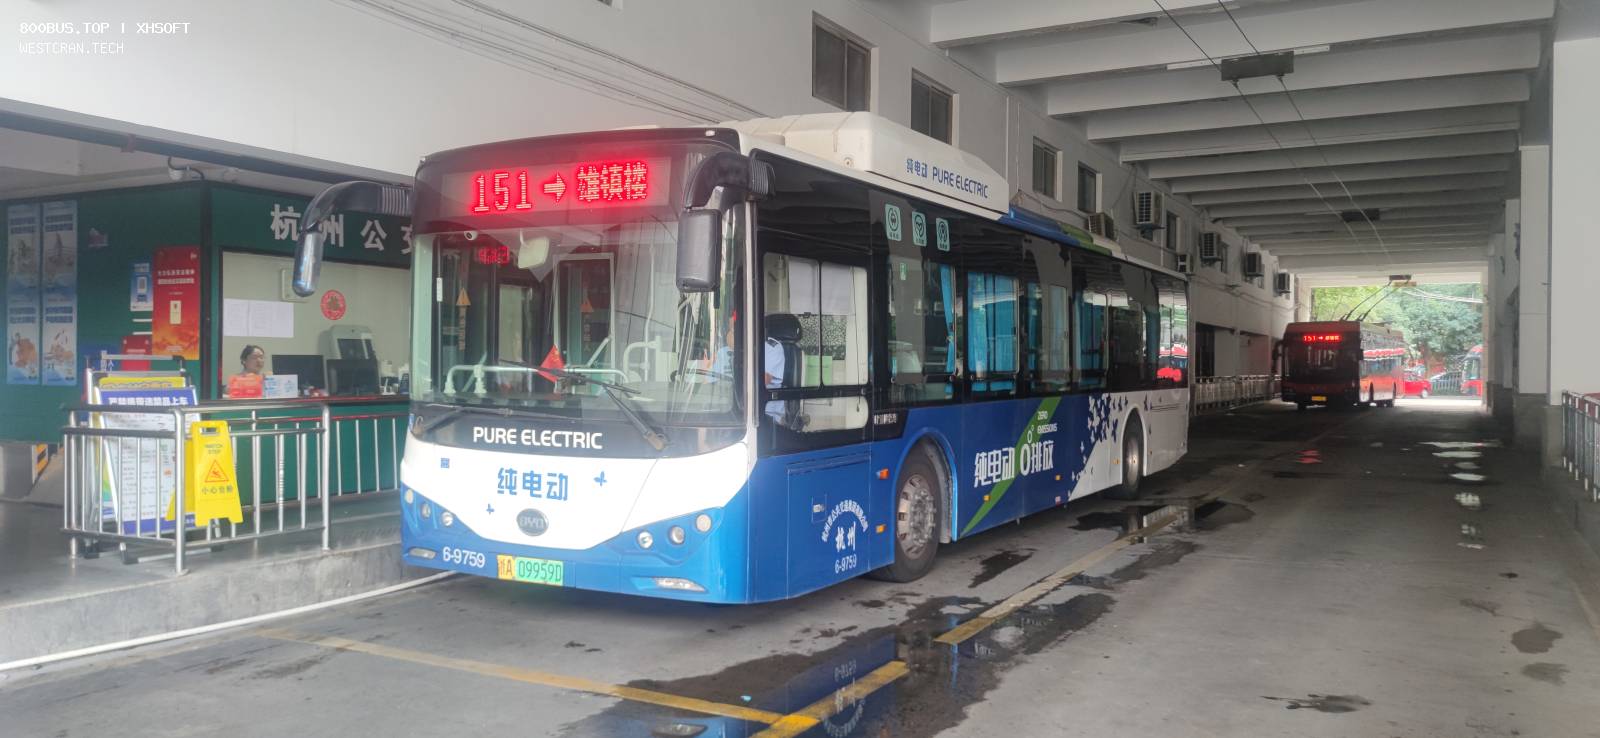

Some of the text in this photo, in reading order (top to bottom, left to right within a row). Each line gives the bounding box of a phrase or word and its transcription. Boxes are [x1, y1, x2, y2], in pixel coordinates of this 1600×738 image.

[474, 162, 647, 213] 151 雄镇楼
[906, 158, 988, 198] 纯电动 PURE ELECTRIC
[1037, 410, 1049, 420] ZERO
[473, 426, 603, 449] PURE ELECTRIC
[1037, 422, 1058, 434] EMISSIONS
[974, 446, 1015, 488] 纯电动
[497, 467, 569, 501] 纯电动
[835, 520, 856, 553] 杭州
[442, 546, 486, 568] 6-9759
[834, 554, 857, 574] 6-9759
[518, 560, 563, 583] 09959D
